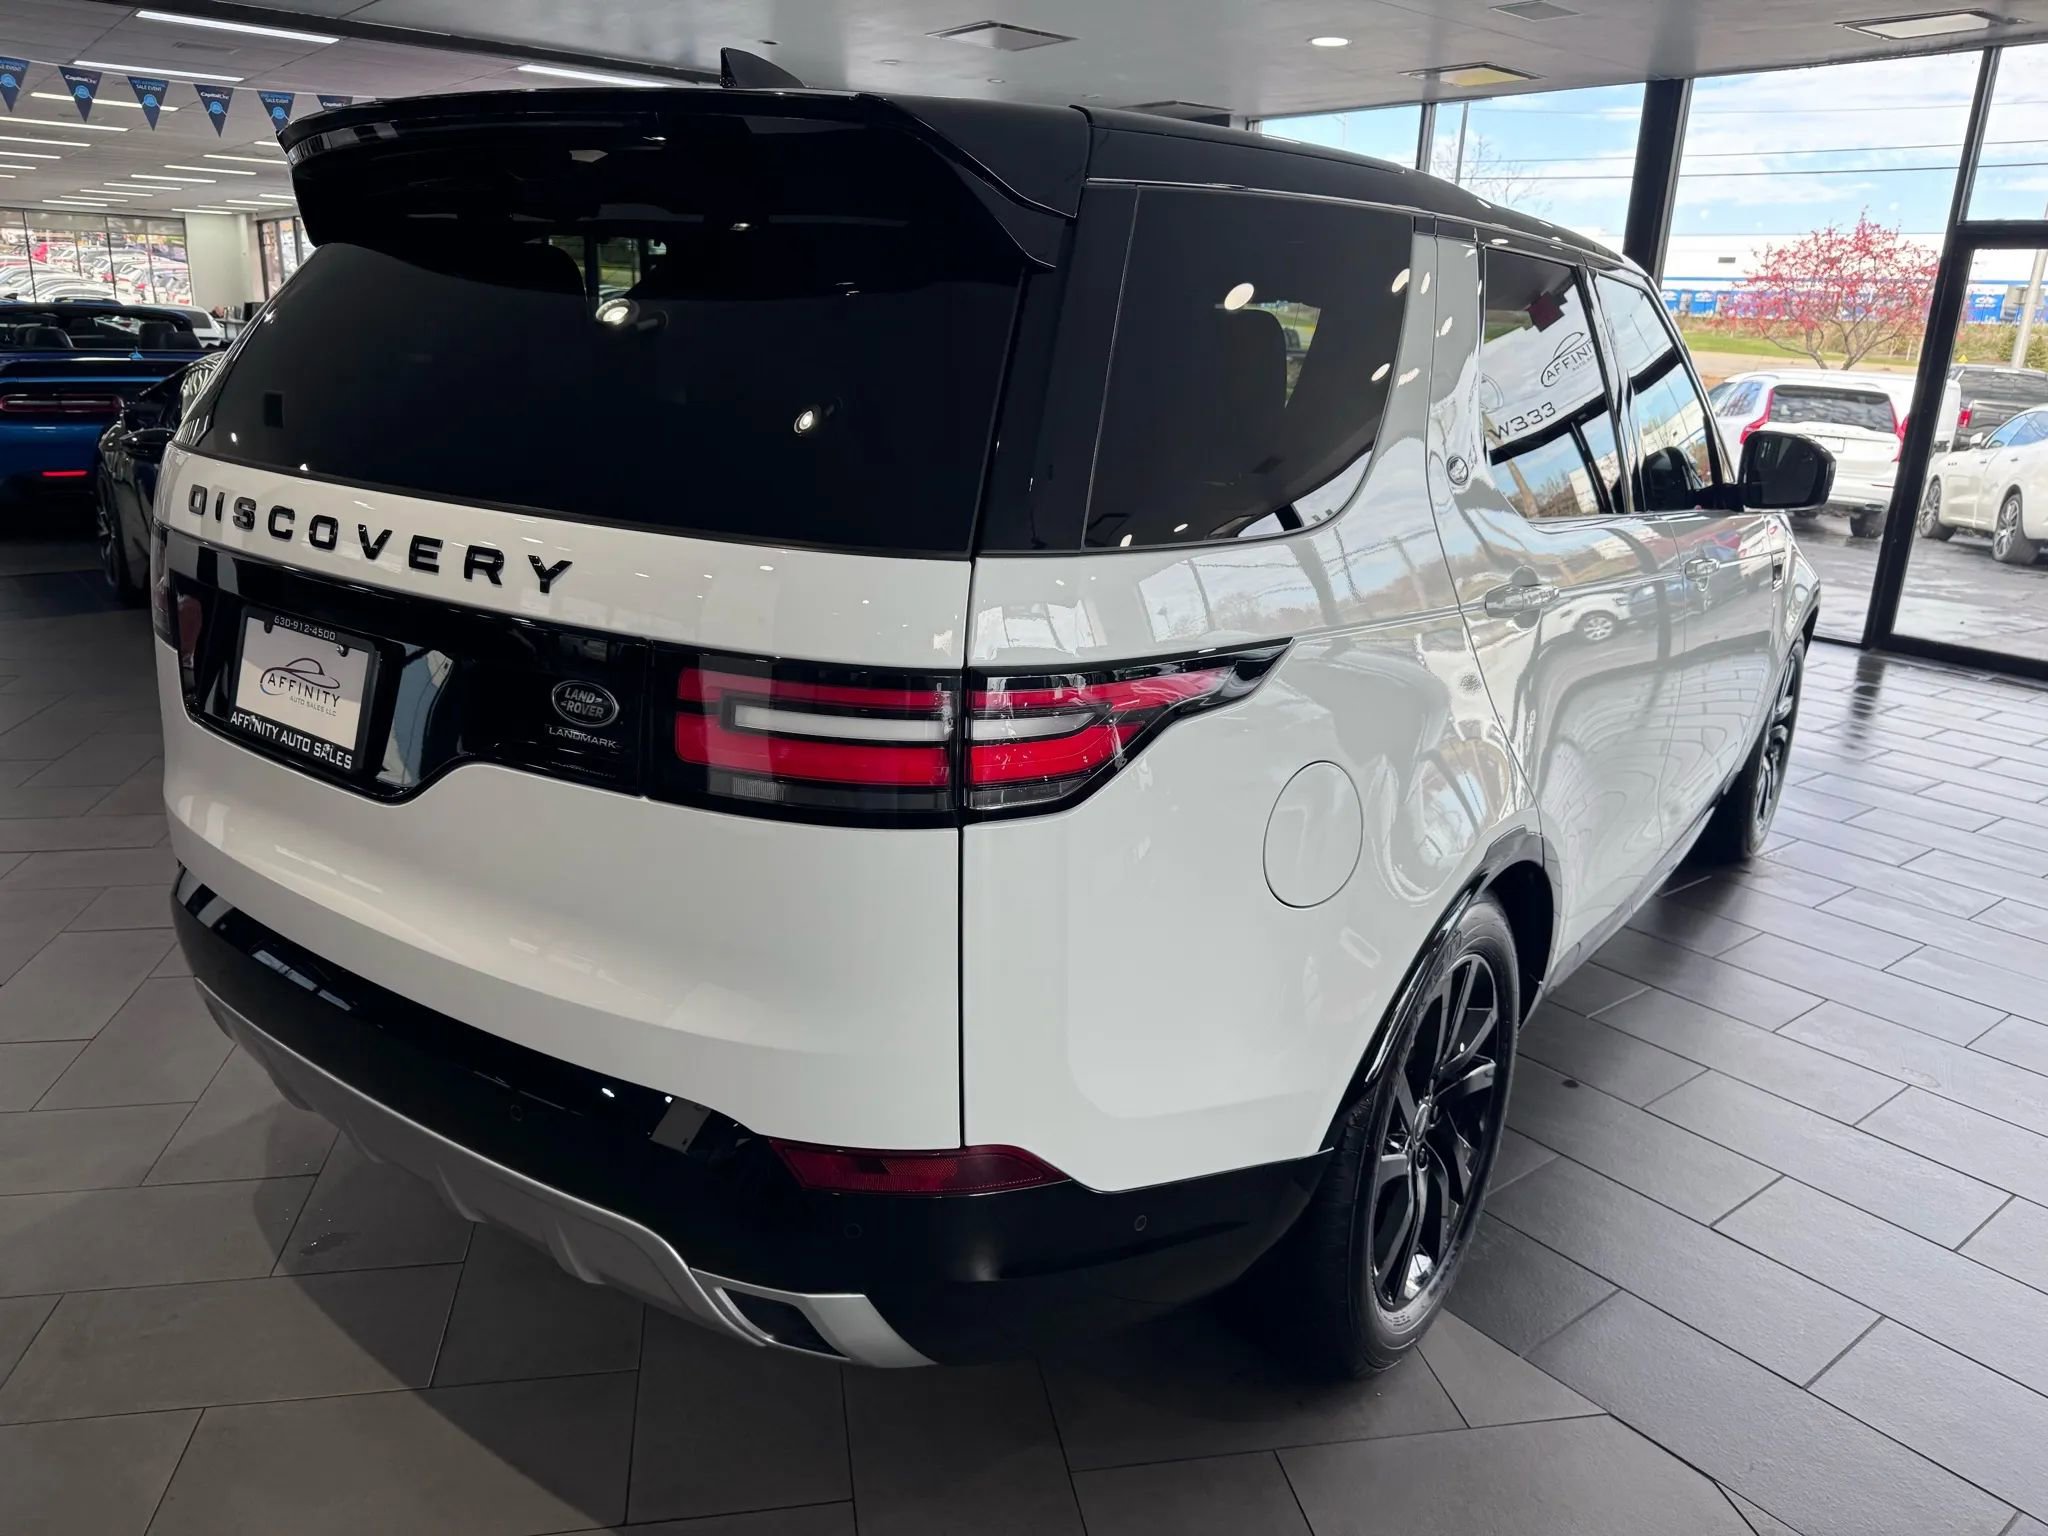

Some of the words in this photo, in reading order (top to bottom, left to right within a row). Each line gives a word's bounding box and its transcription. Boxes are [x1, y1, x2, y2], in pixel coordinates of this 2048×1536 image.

[1545, 340, 1593, 381] AFFINI
[188, 484, 573, 594] DISCOVERY
[274, 615, 336, 641] 630-912-4500
[267, 673, 341, 708] AFFINITY
[564, 687, 596, 704] LAND
[289, 695, 305, 706] AUTO
[306, 701, 325, 713] SALES
[325, 707, 337, 717] LLC
[566, 700, 605, 718] ROVER
[230, 711, 280, 739] AFFINITY
[280, 730, 311, 753] AUTO
[313, 742, 353, 770] SALES
[549, 726, 617, 748] LANDMARK
